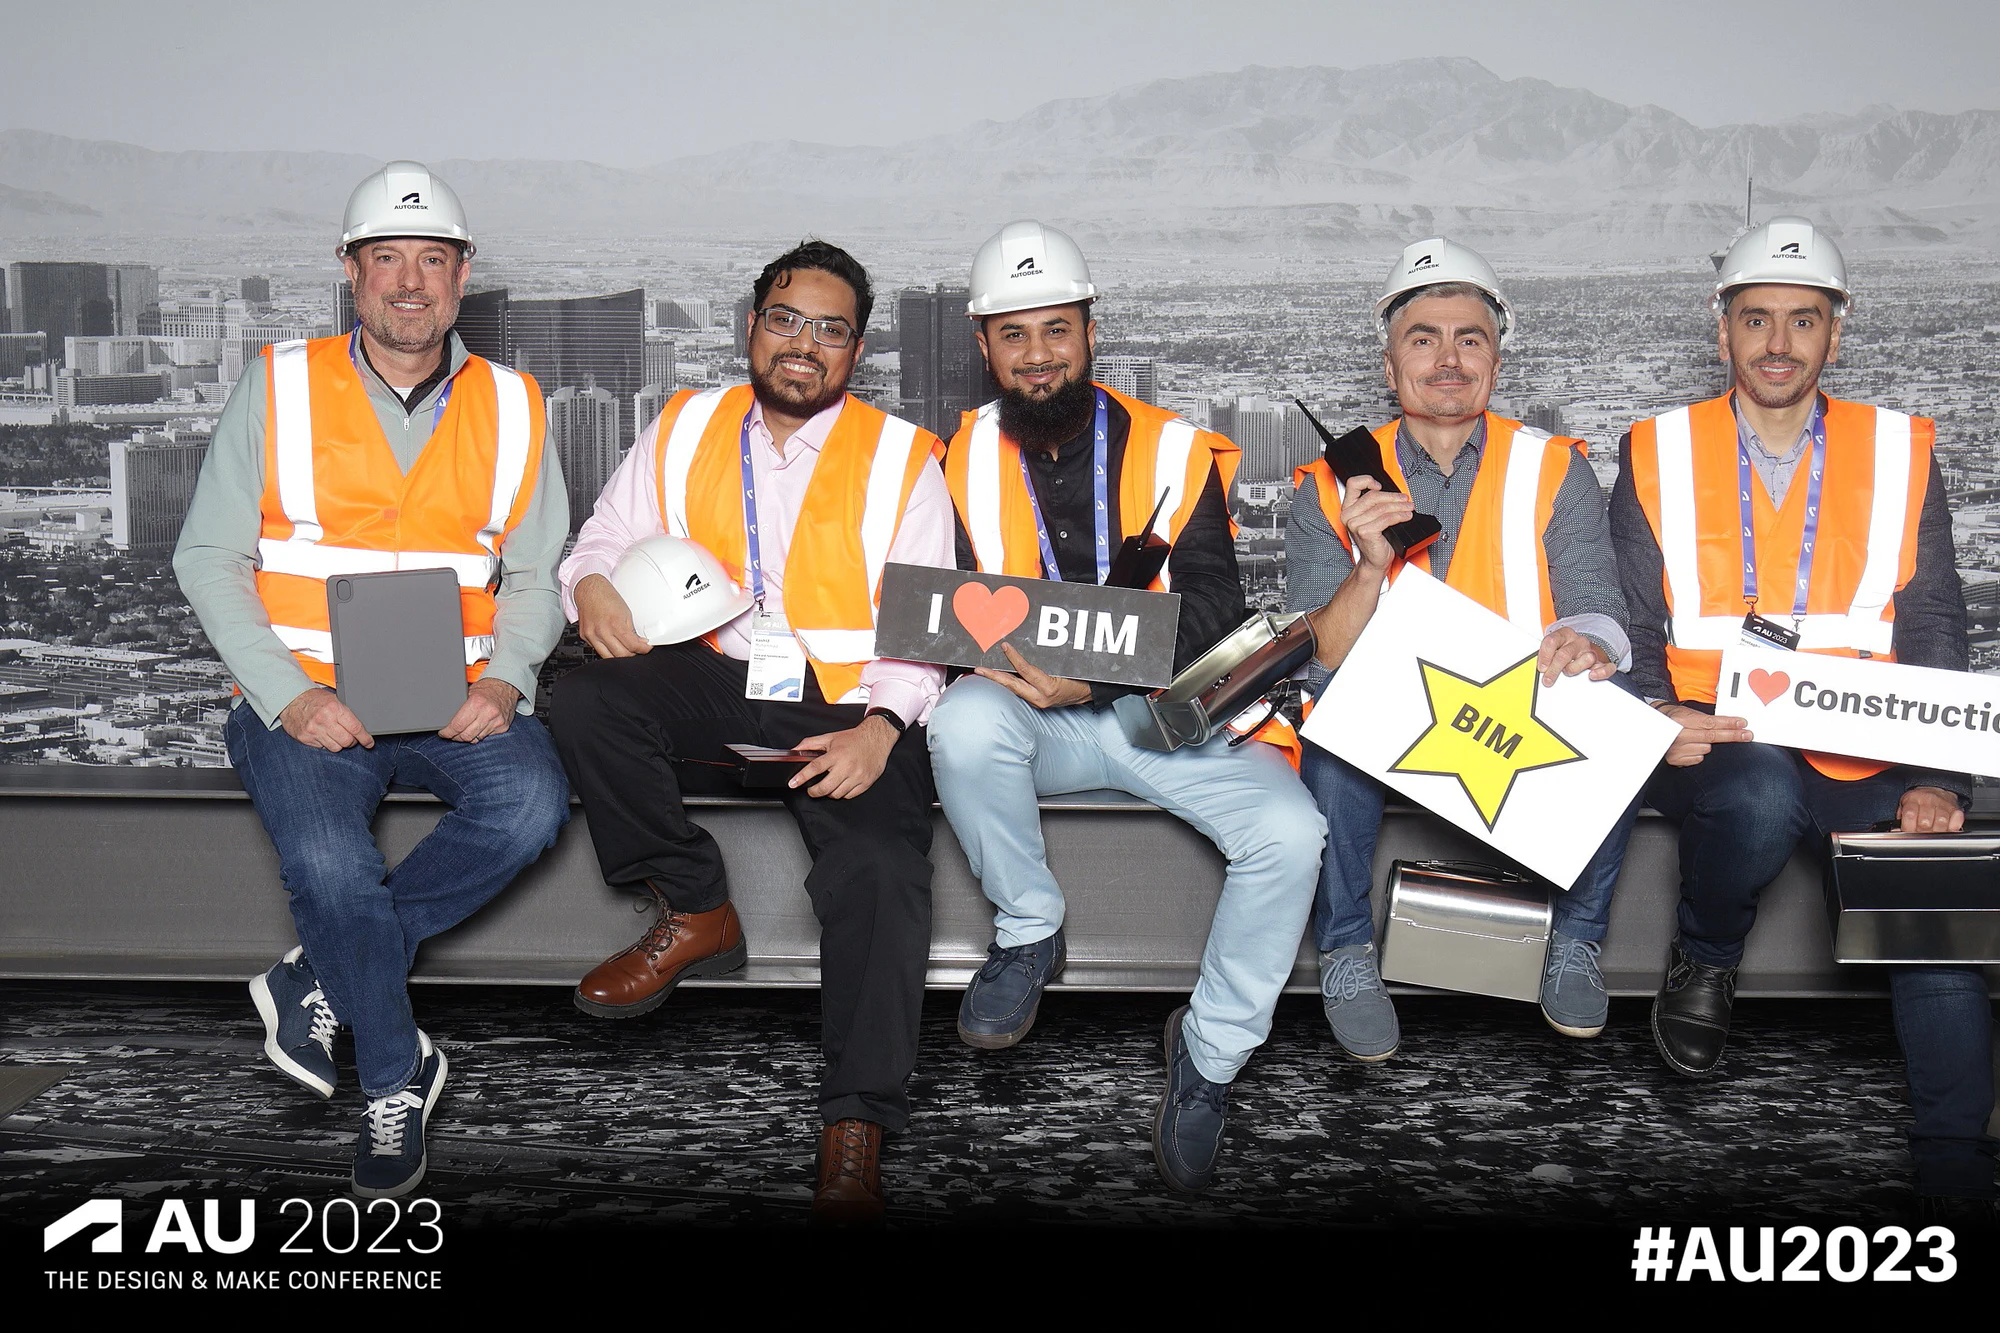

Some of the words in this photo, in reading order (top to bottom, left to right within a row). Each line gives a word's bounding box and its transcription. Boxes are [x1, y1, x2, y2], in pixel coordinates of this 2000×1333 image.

[1010, 269, 1044, 279] AUTODESK
[1407, 263, 1440, 275] AUTODESK
[683, 581, 711, 600] AUTODESK
[927, 593, 943, 634] I
[1036, 605, 1139, 656] BIM
[1761, 629, 1773, 637] AU
[1772, 633, 1788, 644] 2023
[1730, 672, 1740, 698] I
[1450, 702, 1524, 760] BIM
